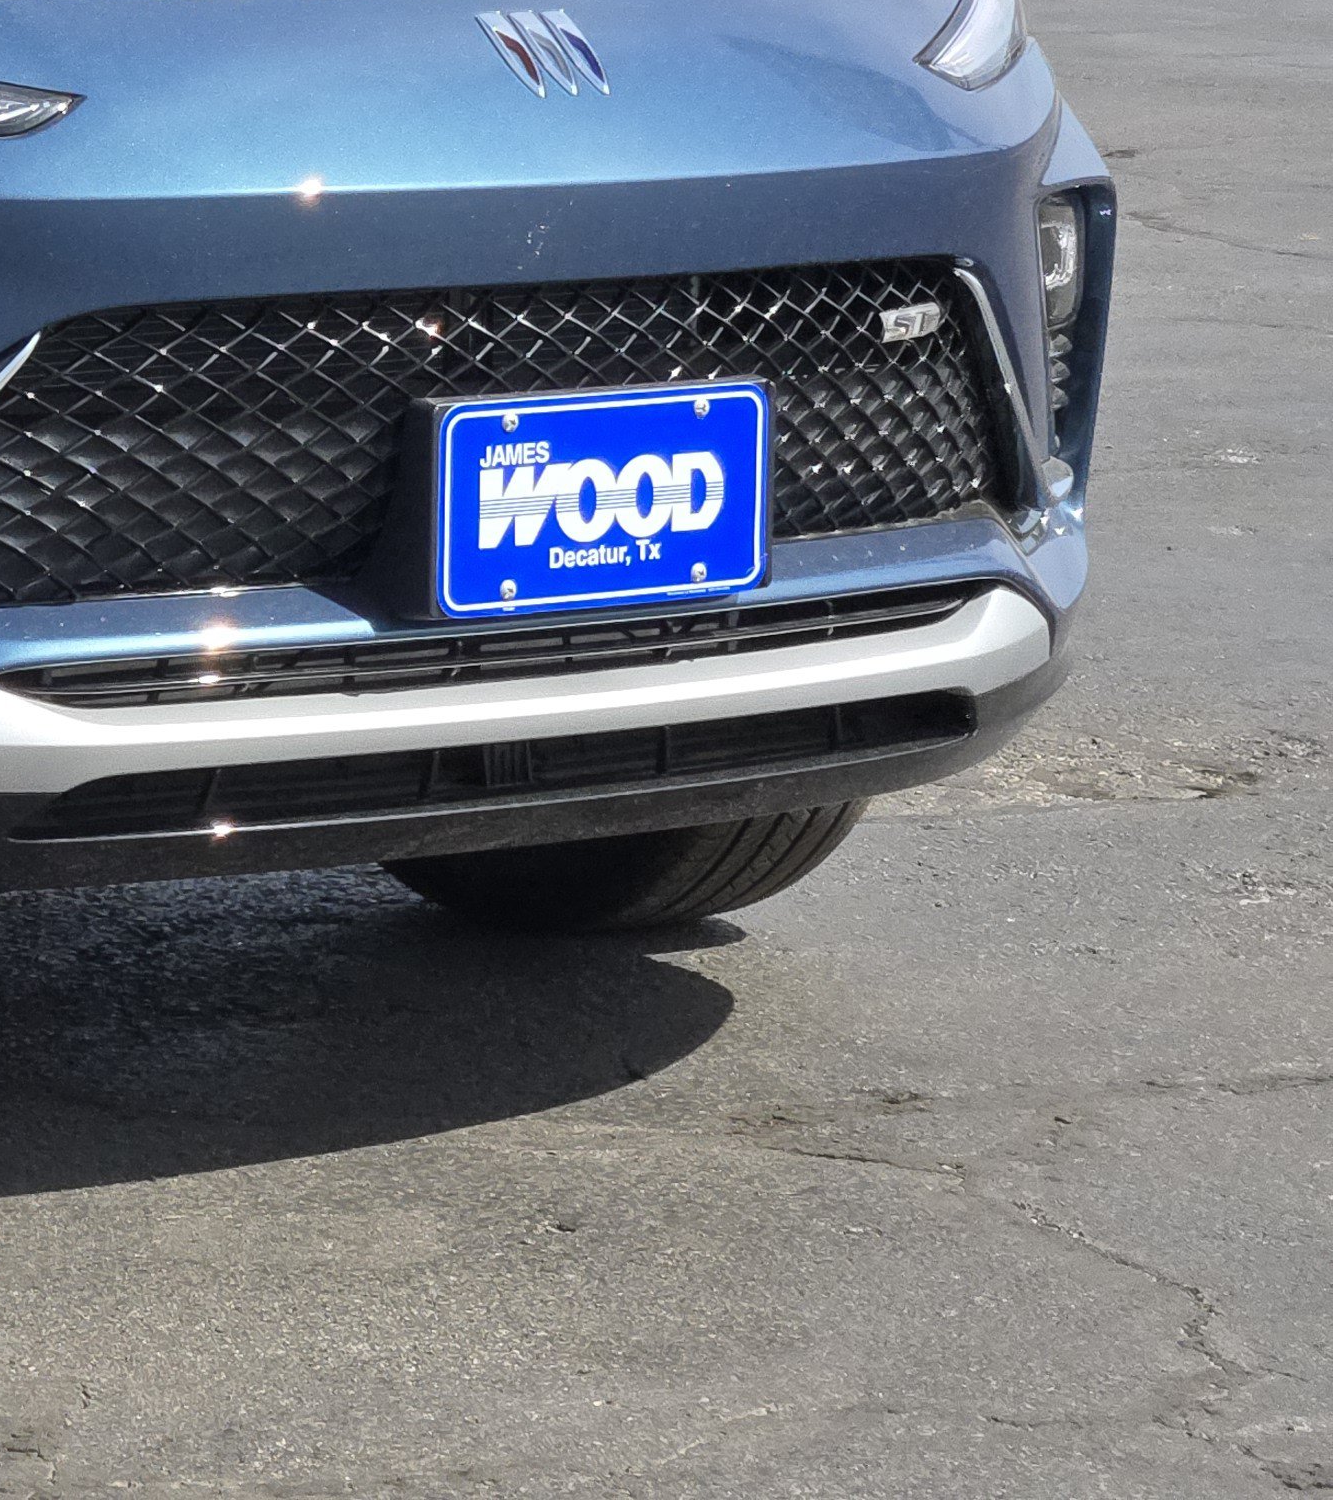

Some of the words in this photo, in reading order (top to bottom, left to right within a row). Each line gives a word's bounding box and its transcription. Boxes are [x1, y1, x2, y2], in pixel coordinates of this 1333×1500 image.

[479, 441, 550, 468] JAMES
[478, 451, 725, 549] WOOD
[549, 544, 632, 569] Decatur,
[636, 539, 661, 561] Tx
